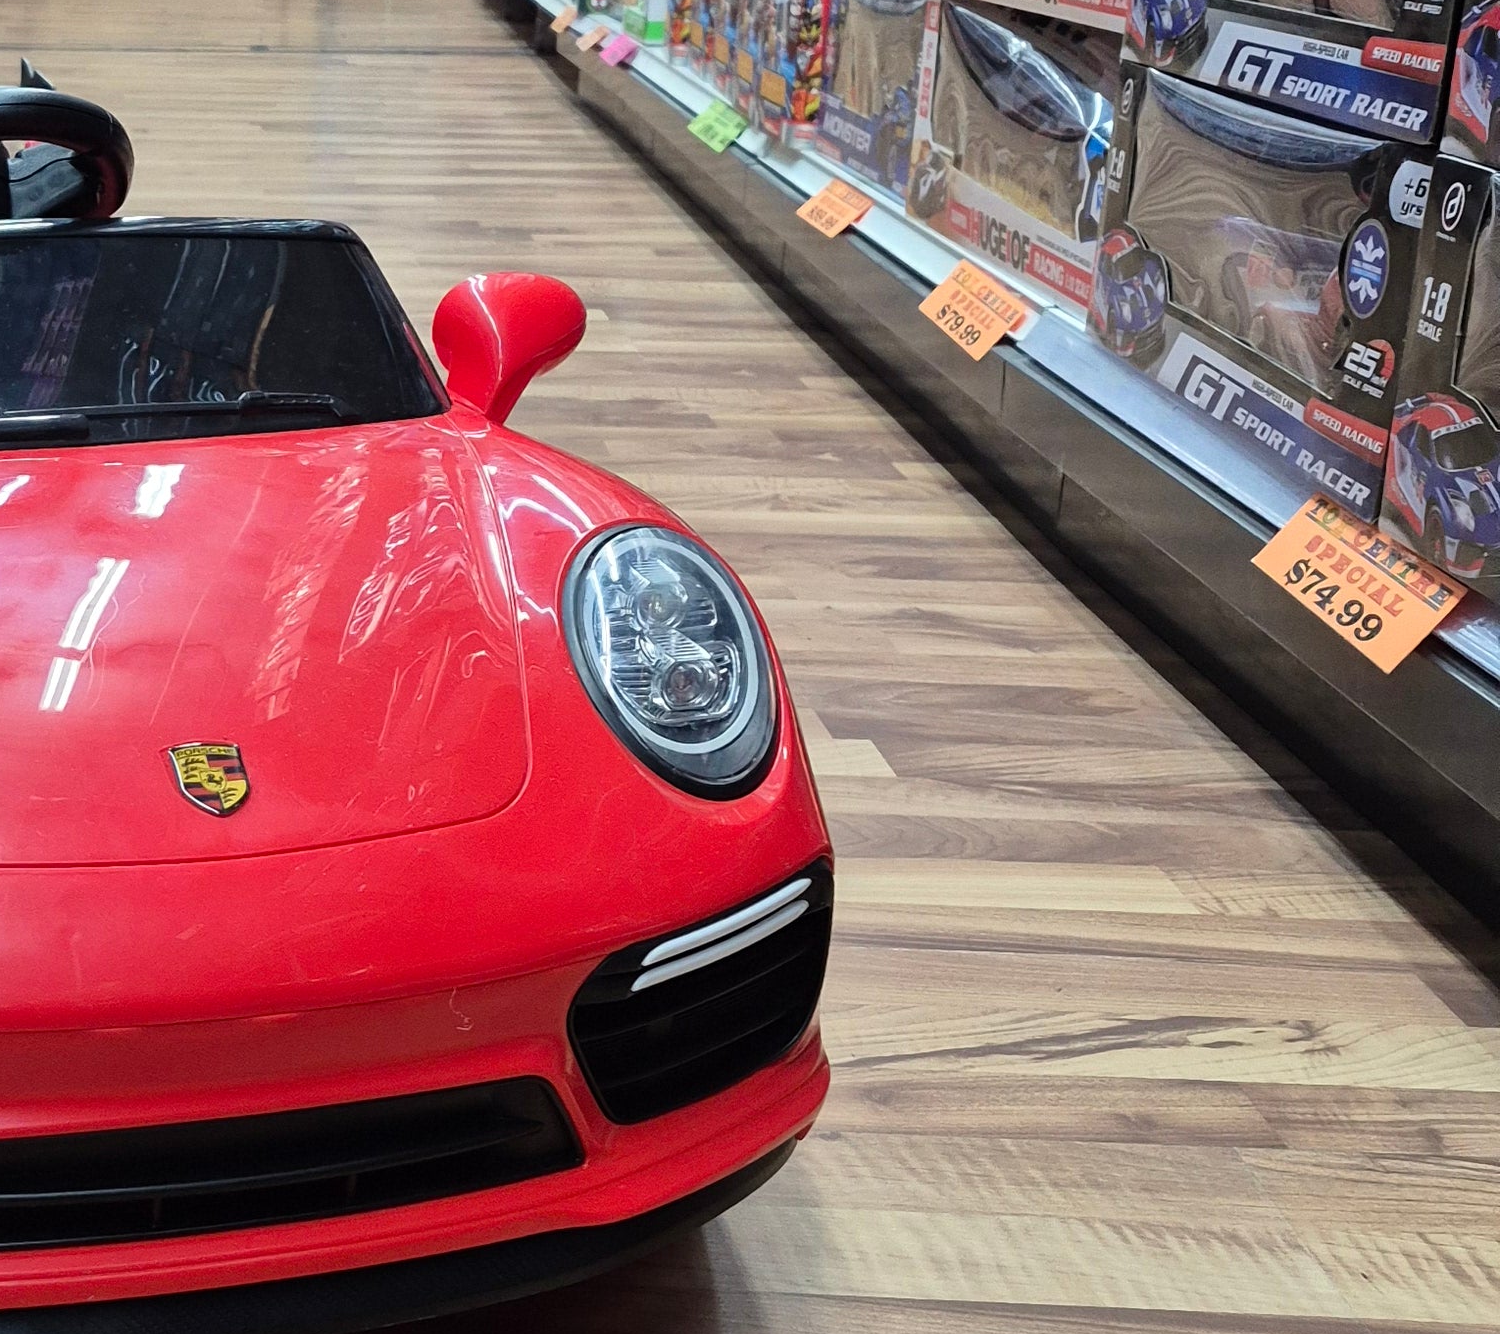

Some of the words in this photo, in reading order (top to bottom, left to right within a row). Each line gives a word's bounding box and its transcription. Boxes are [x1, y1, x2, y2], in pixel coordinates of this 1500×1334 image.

[1371, 46, 1402, 63] SPEED
[1401, 52, 1444, 73] RACING
[1227, 44, 1296, 98] GT
[1279, 75, 1352, 110] SPORT
[1350, 93, 1430, 132] RACER
[822, 112, 873, 156] MONSTER
[1110, 146, 1125, 179] 1:8
[1403, 177, 1431, 199] +6
[1400, 200, 1424, 218] yrs
[1033, 252, 1065, 287] RACING
[1421, 276, 1452, 323] 1:8
[936, 304, 982, 346] $79.99
[1416, 318, 1444, 343] SCALE
[1343, 341, 1382, 379] 25
[1281, 397, 1295, 412] CAR
[1183, 362, 1246, 422] GT
[1231, 405, 1297, 458] SPORT
[1294, 447, 1372, 507] RACER
[1312, 409, 1342, 433] SPEED
[1341, 427, 1386, 455] RACING
[1309, 499, 1351, 536] TOY
[1354, 529, 1455, 607] CENTRE
[1304, 534, 1406, 618] SPECIAL
[1284, 558, 1383, 642] $74.99
[175, 747, 235, 759] PORSCHE
